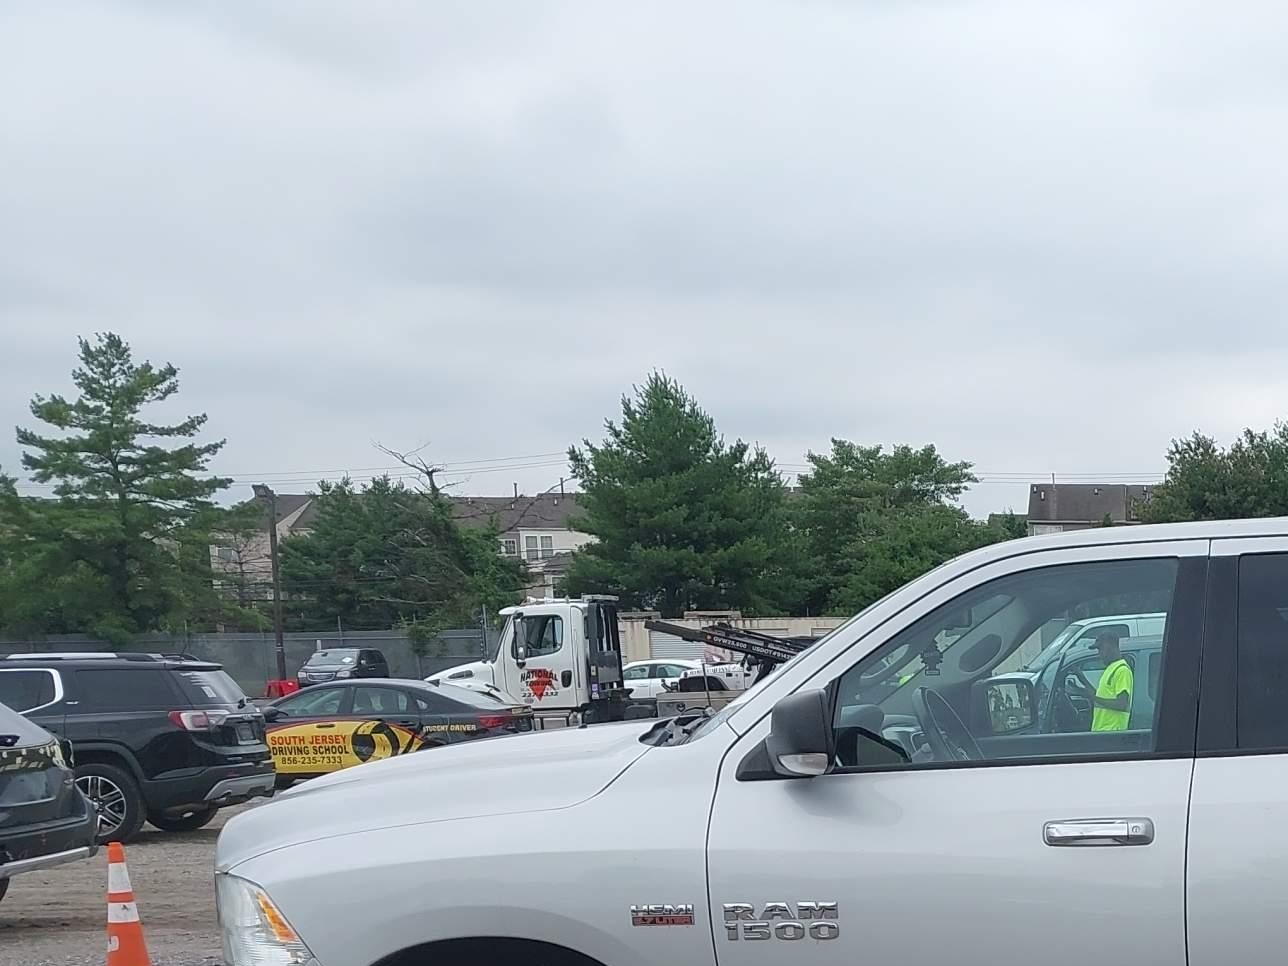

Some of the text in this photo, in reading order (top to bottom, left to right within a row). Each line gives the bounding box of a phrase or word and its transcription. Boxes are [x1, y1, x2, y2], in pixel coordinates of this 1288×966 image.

[520, 670, 558, 682] NATIONAL
[271, 735, 346, 745] SOUTH JERSEY
[272, 745, 349, 756] DRIVING SCHOOL
[281, 756, 342, 765] 856-235-7333
[630, 904, 694, 916] HEMI
[723, 901, 839, 921] RAM
[724, 921, 840, 941] 1500
